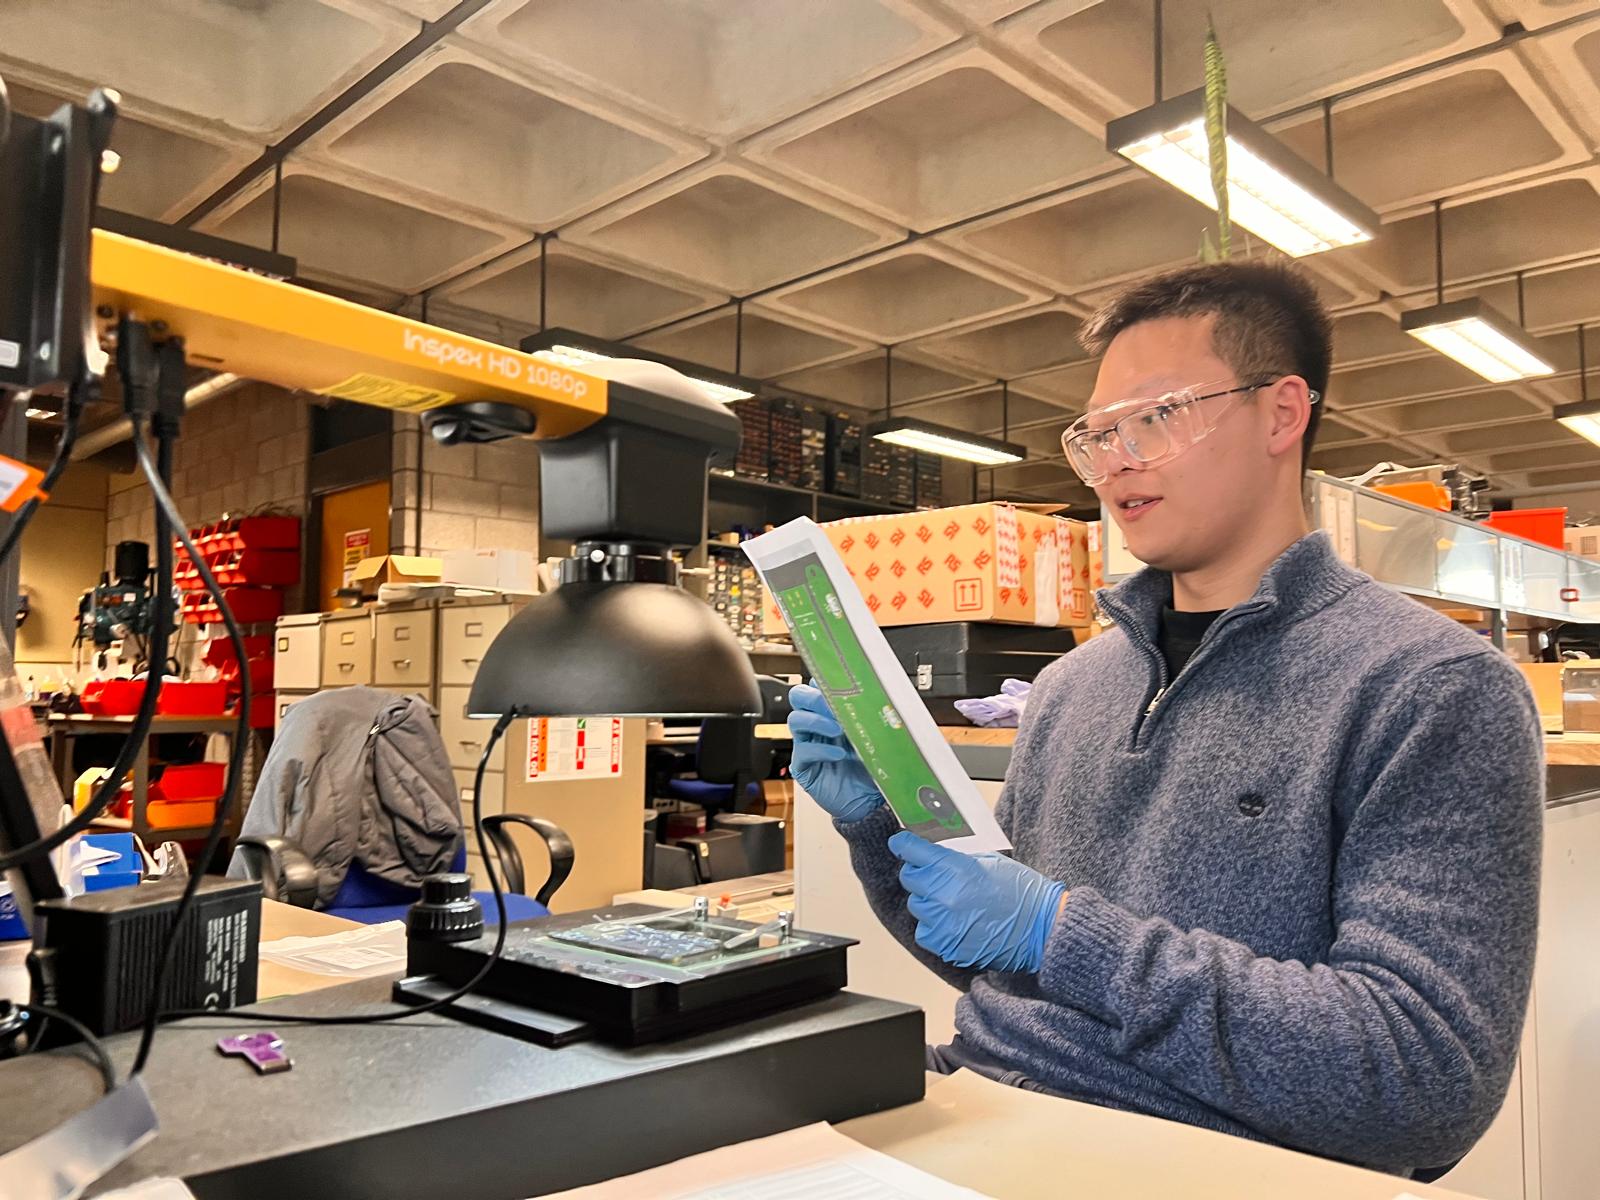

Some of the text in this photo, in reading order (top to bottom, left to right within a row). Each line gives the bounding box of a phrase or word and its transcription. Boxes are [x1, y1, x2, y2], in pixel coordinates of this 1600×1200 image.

[403, 328, 588, 400] Inspex HD 1080p
[530, 738, 540, 758] YOU
